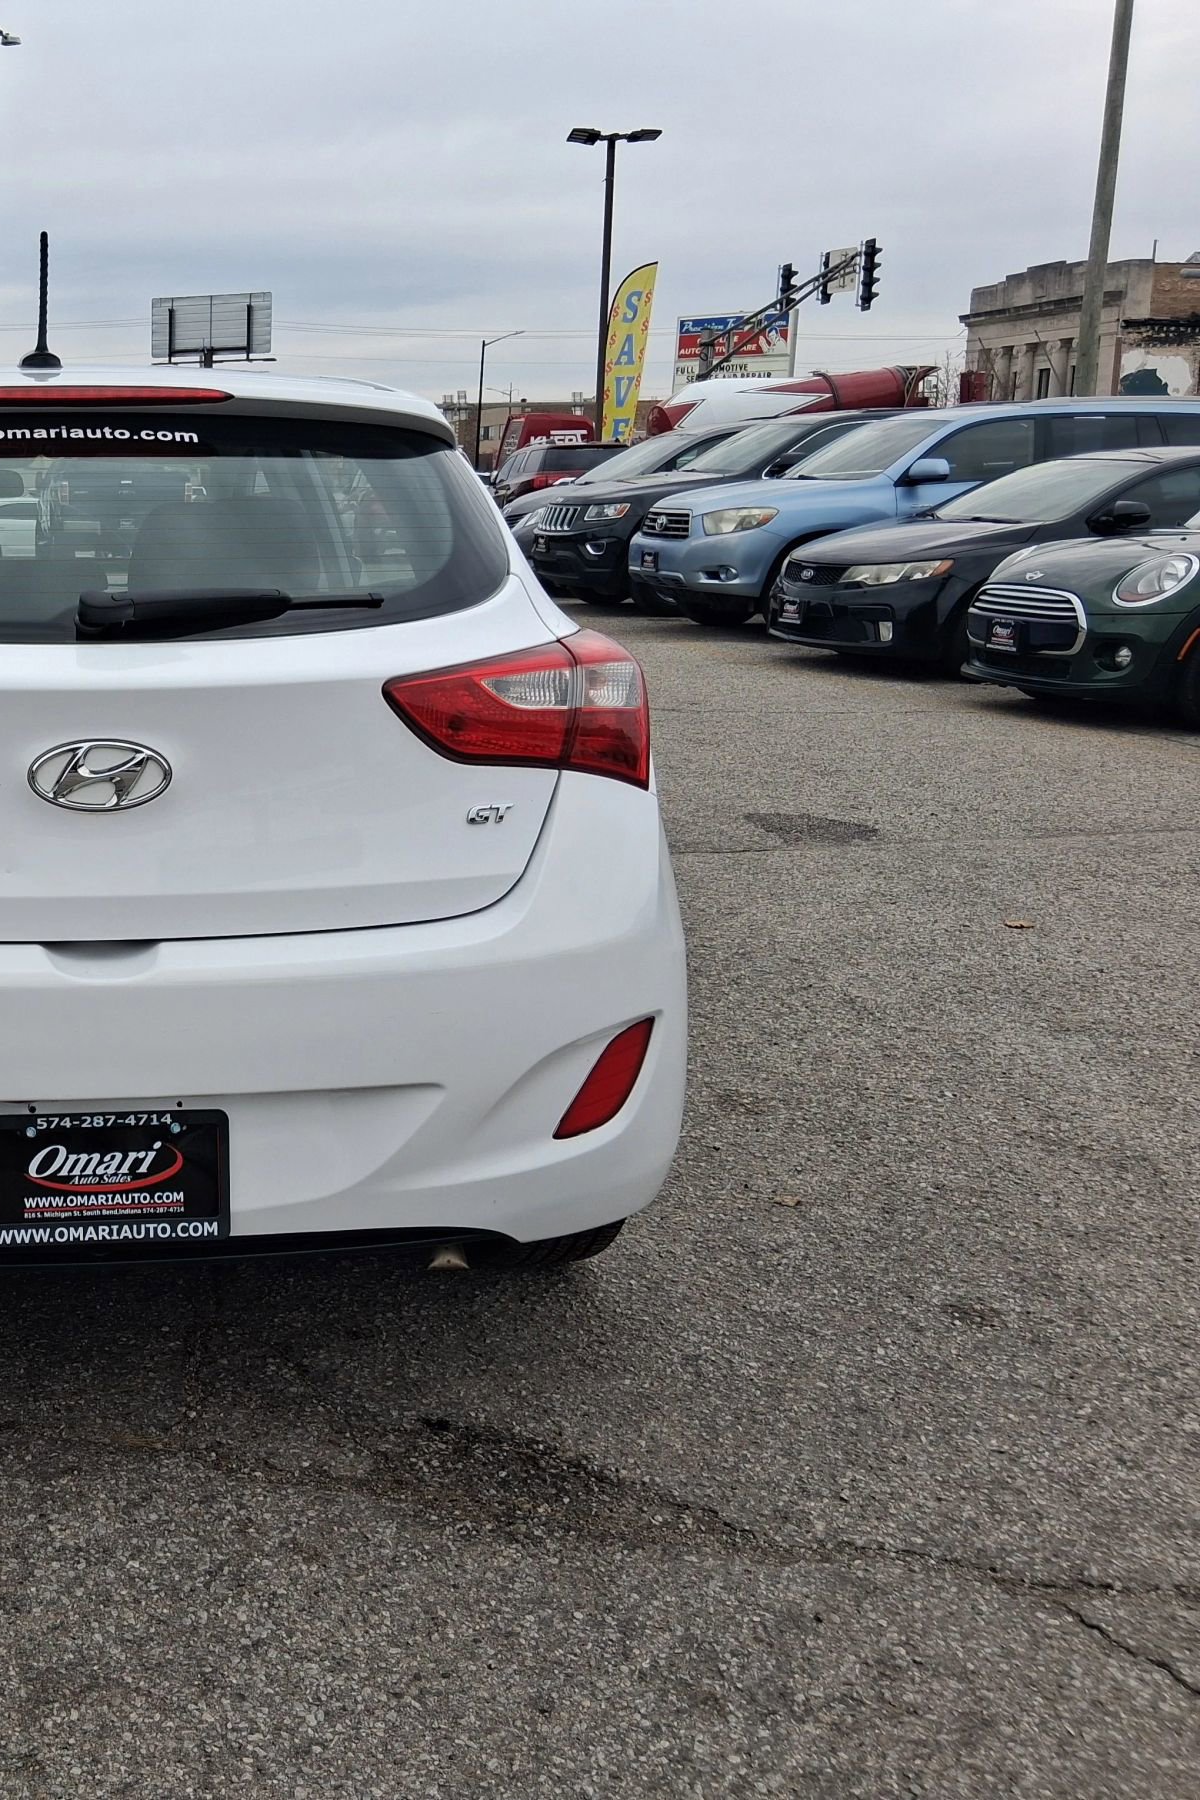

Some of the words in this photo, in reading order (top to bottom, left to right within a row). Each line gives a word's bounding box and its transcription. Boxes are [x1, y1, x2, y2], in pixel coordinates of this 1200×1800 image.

[466, 802, 514, 825] GT
[36, 1113, 173, 1130] 574-287-4714
[28, 1140, 163, 1179] Omari
[69, 1174, 99, 1185] Auto
[100, 1173, 133, 1184] Sales
[24, 1191, 185, 1208] WWW.OMARIAUTO.COM
[43, 1210, 73, 1219] Michigan
